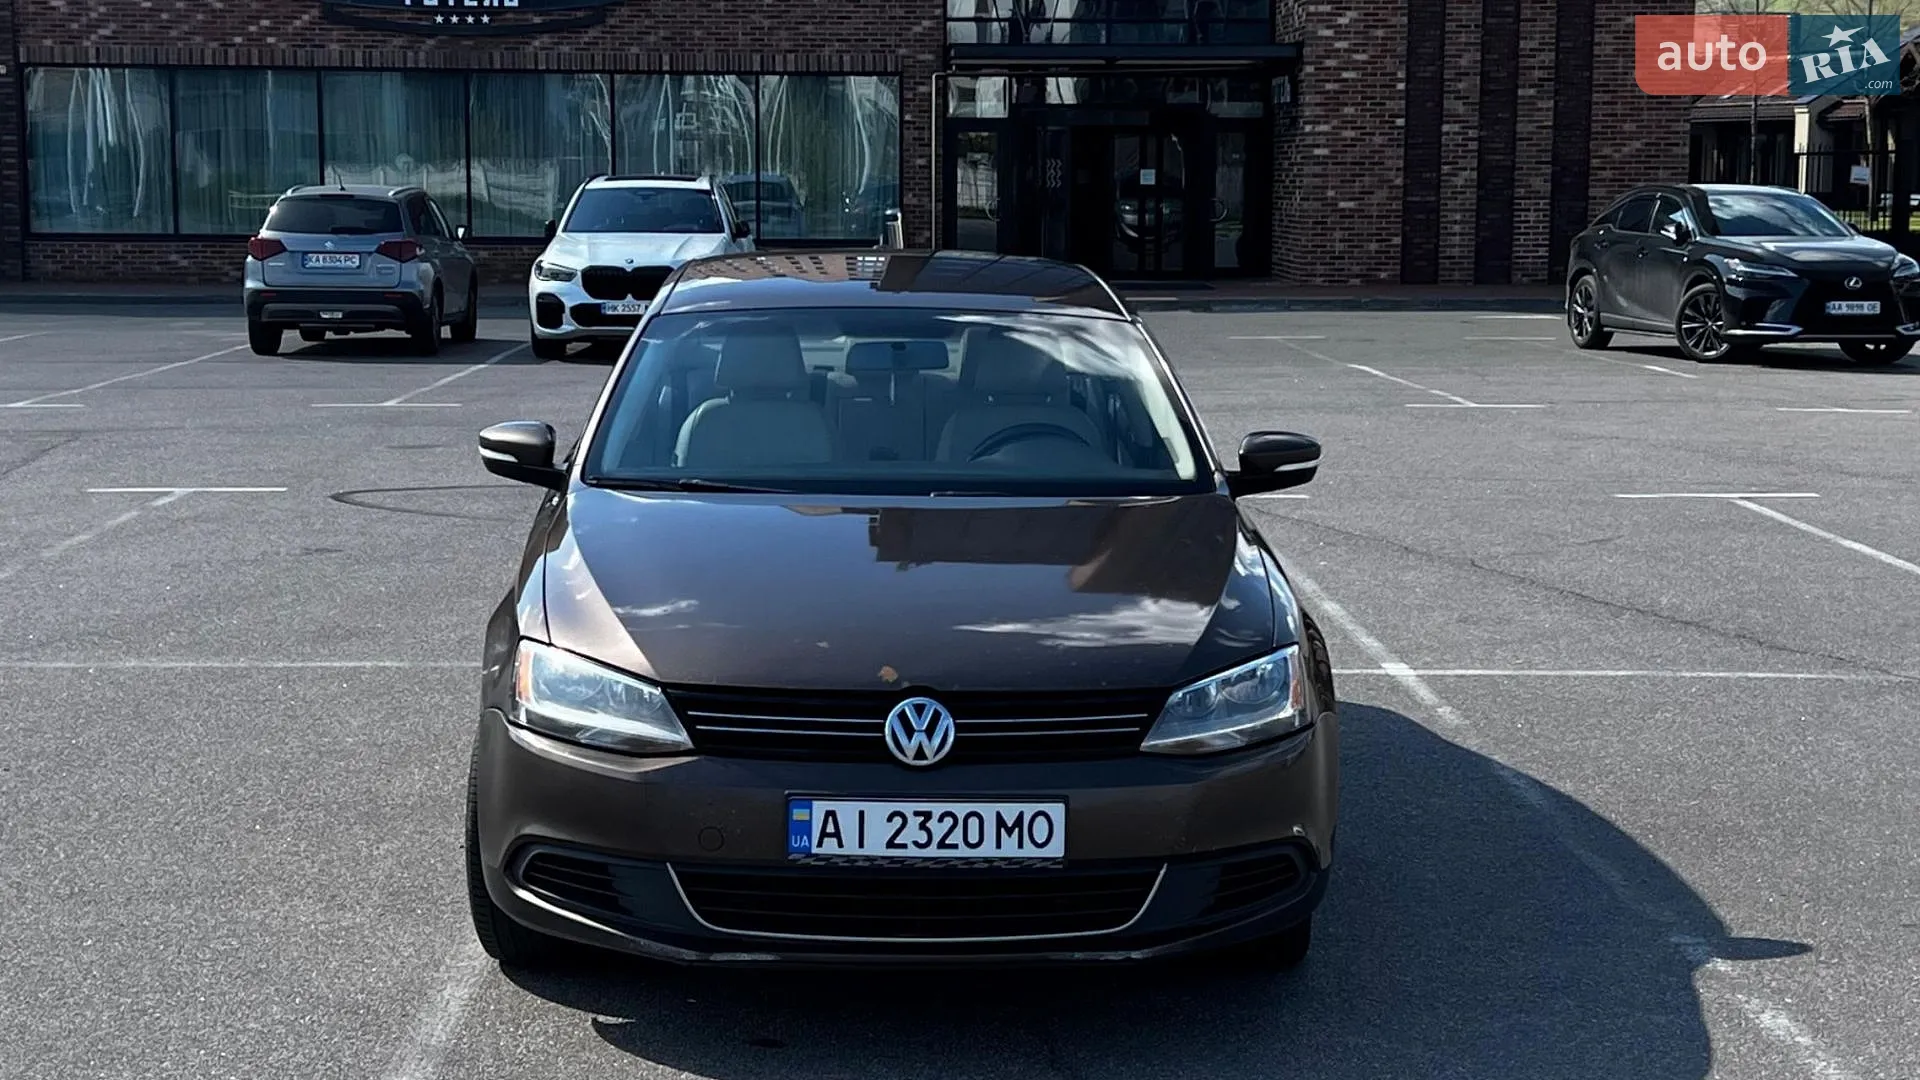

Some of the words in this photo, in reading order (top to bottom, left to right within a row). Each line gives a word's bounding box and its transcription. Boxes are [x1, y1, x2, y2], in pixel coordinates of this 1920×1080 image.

[1831, 303, 1843, 312] AA
[816, 809, 865, 849] AI
[885, 810, 985, 850] 2320
[995, 809, 1055, 850] MO
[791, 835, 810, 847] UA
